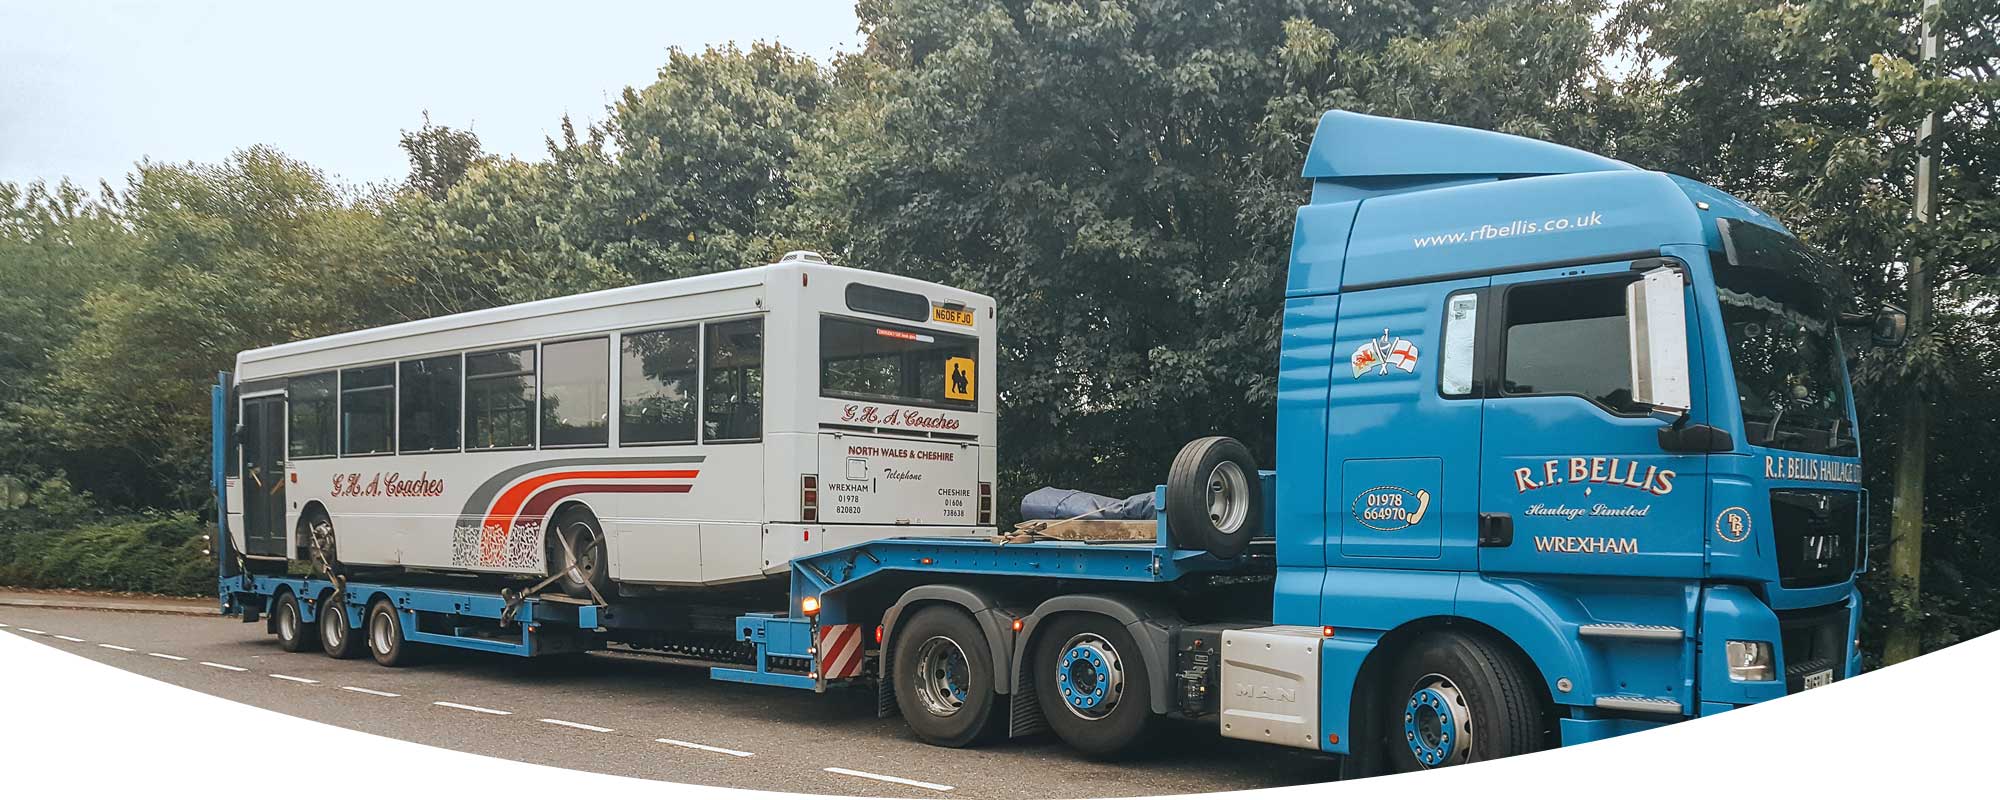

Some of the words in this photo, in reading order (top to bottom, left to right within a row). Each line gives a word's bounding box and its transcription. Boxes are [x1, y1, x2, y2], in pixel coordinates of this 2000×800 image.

[1413, 211, 1602, 249] www.rfbellis.co.uk
[935, 308, 955, 320] N606
[903, 409, 960, 431] Coaches
[848, 446, 880, 457] NORTH
[880, 448, 908, 459] WALES
[909, 451, 916, 460] &
[917, 451, 954, 462] CHESHIRE
[884, 467, 922, 482] Telephone
[1514, 460, 1563, 494] R.F.
[1568, 456, 1676, 496] BELLIS
[1787, 457, 1818, 480] BELLIS
[1820, 460, 1853, 483] HAULAGE
[383, 471, 444, 497] Coaches
[829, 483, 869, 492] WREXHAM
[838, 495, 859, 503] 01978
[938, 488, 970, 497] CHESHIRE
[1367, 493, 1403, 507] 01978
[836, 505, 861, 514] 820820
[945, 499, 963, 507] 01606
[943, 508, 965, 517] 738638
[1364, 507, 1406, 521] 664970
[1524, 503, 1586, 521] Haulage
[1588, 503, 1650, 518] Limited
[1534, 535, 1639, 554] WREXHAM
[1234, 681, 1297, 703] MAN
